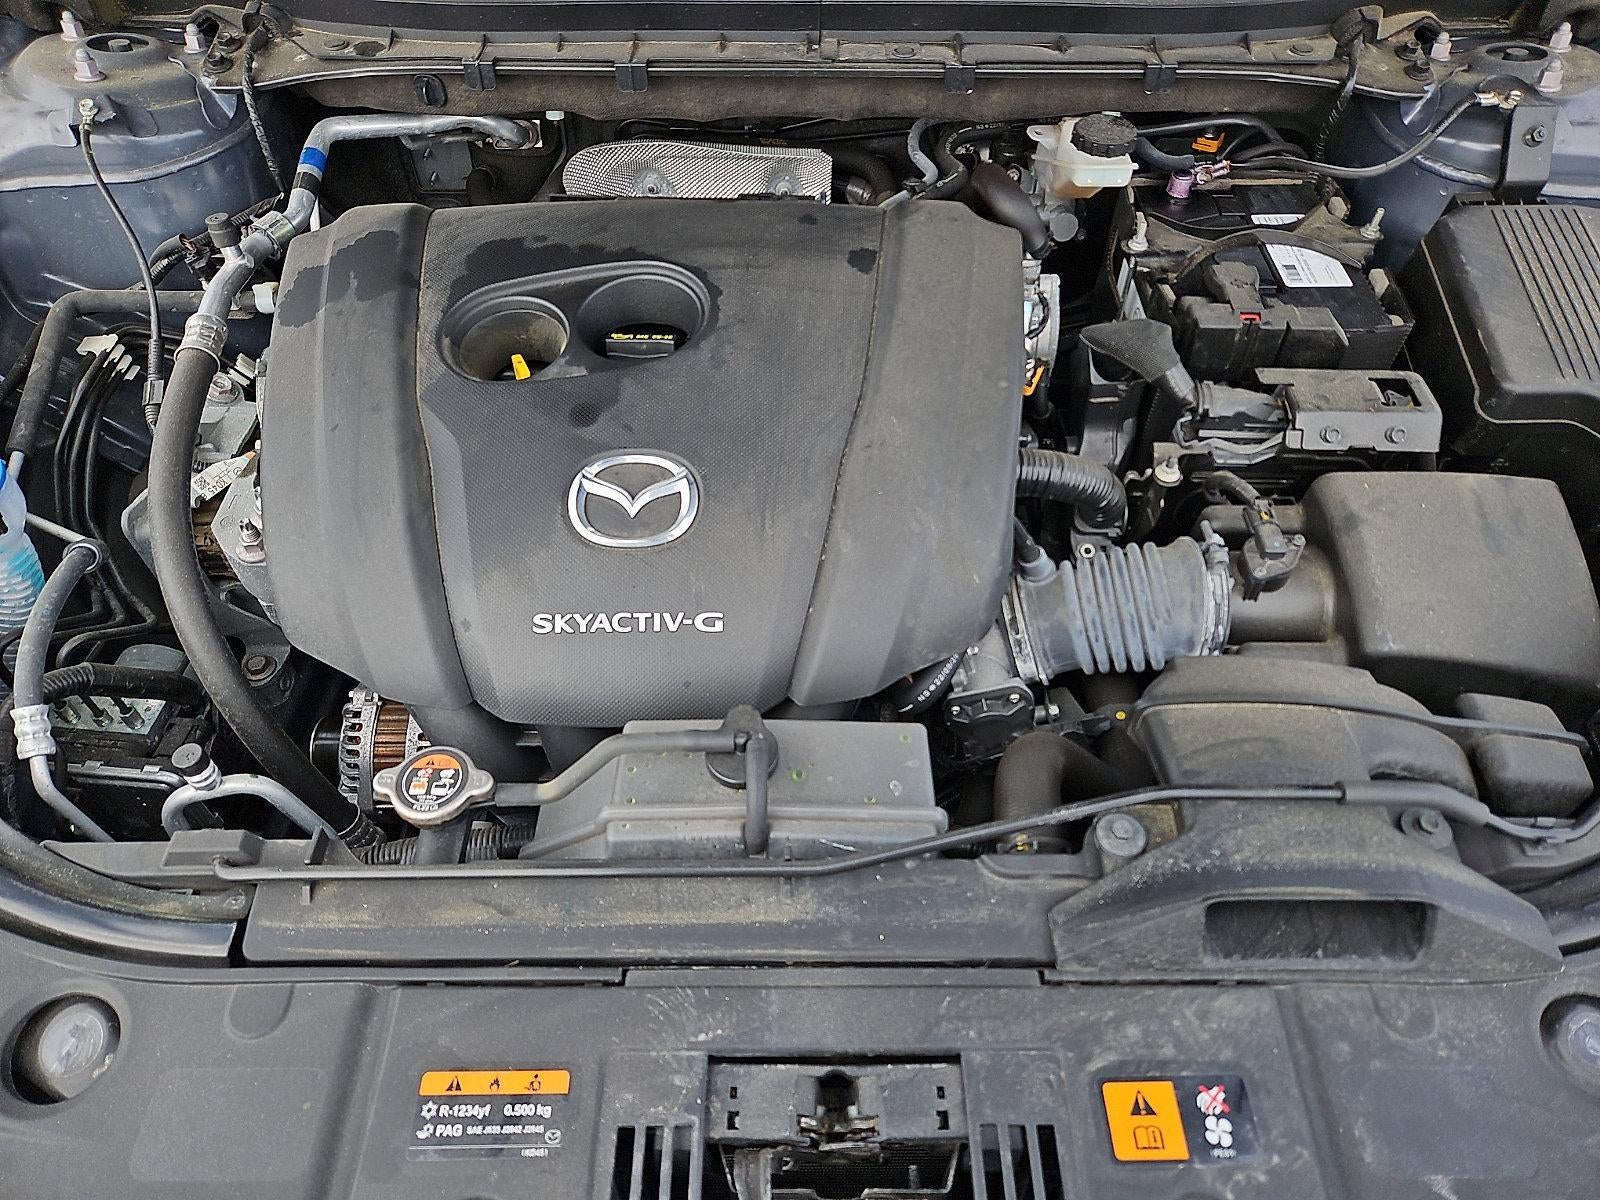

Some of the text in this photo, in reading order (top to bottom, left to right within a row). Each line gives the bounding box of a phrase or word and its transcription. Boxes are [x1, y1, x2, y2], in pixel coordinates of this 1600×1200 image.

[532, 611, 725, 634] SKYACTIV-G
[438, 1103, 552, 1120] R-1234yf 0.500 kg
[435, 1123, 463, 1138] PAG
